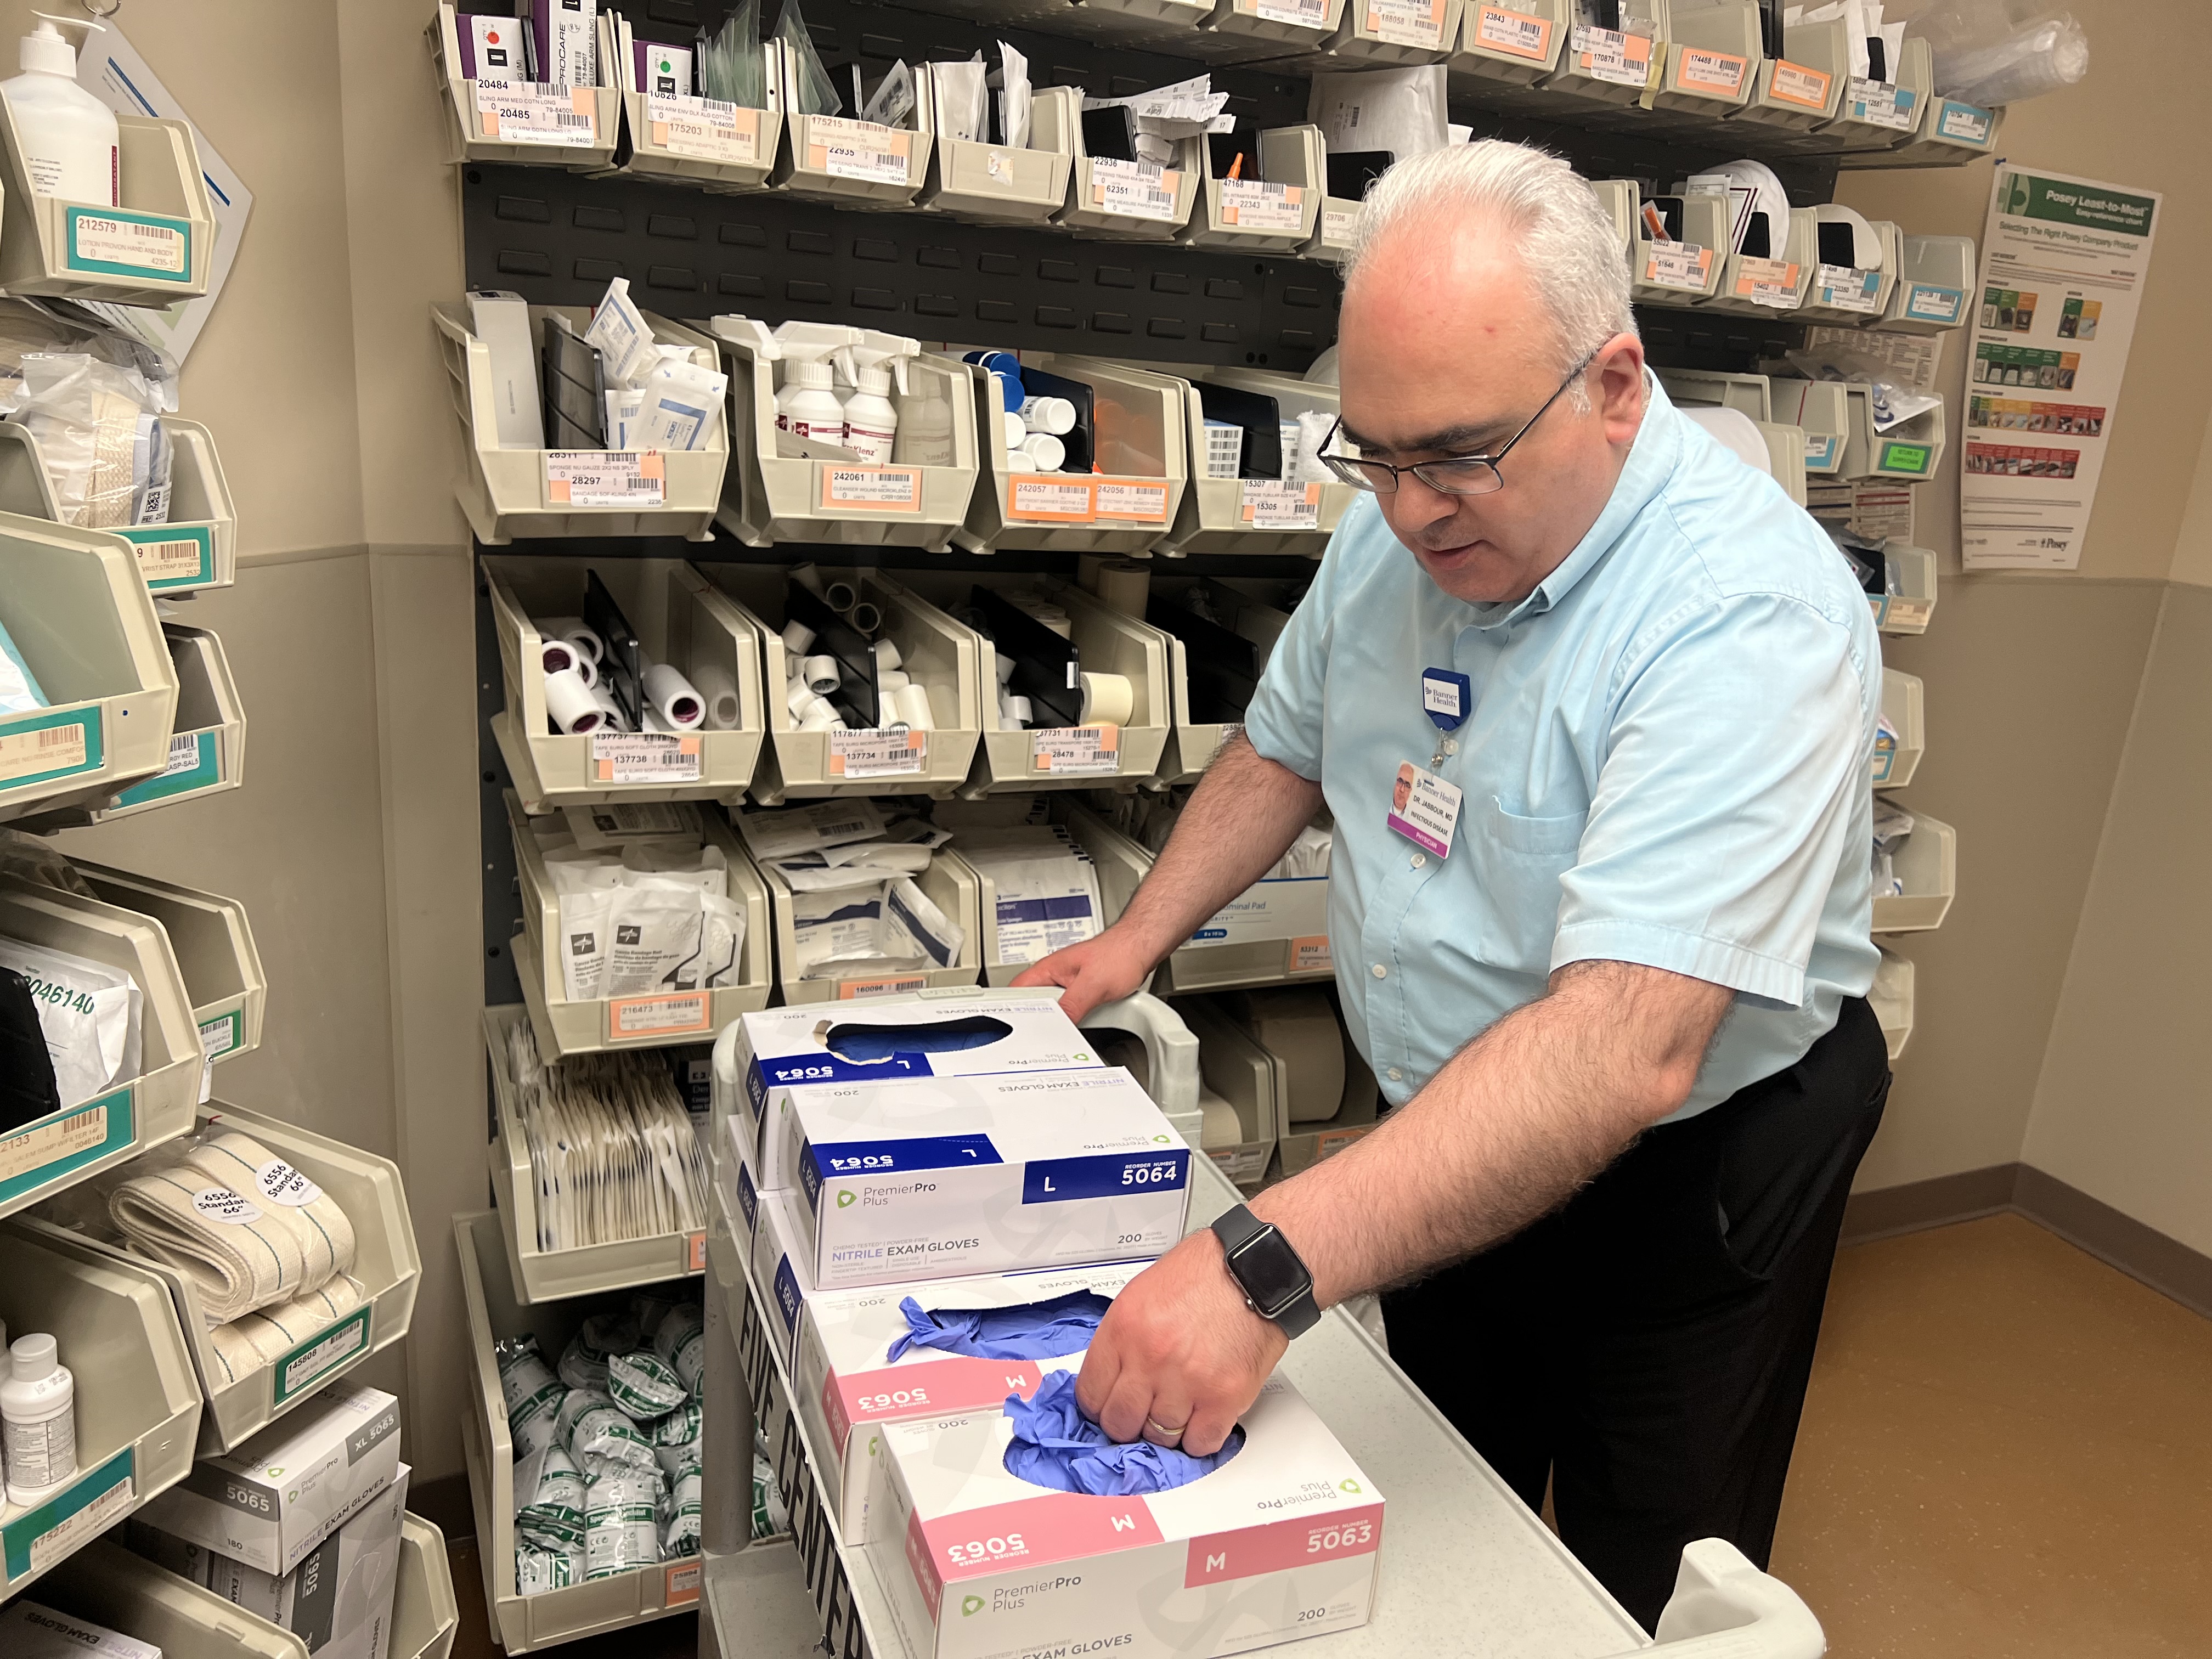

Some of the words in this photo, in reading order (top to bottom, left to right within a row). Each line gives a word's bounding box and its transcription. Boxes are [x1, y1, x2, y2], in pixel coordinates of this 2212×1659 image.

[1381, 14, 1404, 25] 188058
[1486, 12, 1505, 23] 23843
[1594, 53, 1615, 63] 170878
[1691, 55, 1712, 65] 174488
[478, 80, 508, 89] 20484
[500, 109, 529, 119] 20485
[811, 117, 843, 128] 175215
[669, 123, 702, 136] 175203
[830, 148, 854, 156] 22935
[1095, 156, 1118, 167] 22936
[1107, 185, 1128, 195] 62351
[1223, 180, 1244, 188] 47168
[2046, 190, 2078, 206] Posey
[1240, 200, 1260, 209] 22343
[1326, 213, 1345, 222] 29706
[78, 218, 116, 233] 212579
[1999, 221, 2029, 235] Selecting
[2031, 226, 2043, 235] The
[2044, 228, 2061, 239] Right
[2062, 232, 2080, 243] Posey
[2083, 235, 2112, 248] Company
[2113, 240, 2138, 250] Product
[78, 239, 100, 247] LOTION
[834, 473, 864, 481] 242061
[1018, 484, 1047, 493] 242057
[1097, 486, 1124, 494] 242056
[137, 548, 143, 557] 9
[1433, 689, 1457, 700] Banner
[1434, 697, 1456, 707] Health
[1, 758, 20, 767] CARE
[21, 752, 55, 763] NO-RINSE
[614, 755, 647, 764] 137738
[1422, 782, 1440, 798] Banner
[1440, 792, 1455, 807] Health
[1421, 800, 1444, 818] JABBOUR,
[1445, 812, 1453, 821] MD
[1410, 810, 1432, 827] INFECTIOUS
[1432, 823, 1448, 837] DISEASE
[1416, 832, 1437, 849] PHYSICIAN
[622, 1006, 653, 1014] 216473
[211, 1034, 231, 1046] BUCKLE
[896, 1060, 911, 1070] L
[1009, 1057, 1069, 1065] PremierPro
[775, 1065, 834, 1076] 5064
[1045, 1081, 1080, 1090] EXAM
[1082, 1078, 1126, 1086] NITRILE
[998, 1084, 1042, 1093] GLOVES
[13, 1147, 36, 1163] SALEM
[36, 1143, 57, 1155] SUMP
[57, 1131, 87, 1147] W/FILTER
[89, 1127, 99, 1135] 14F
[1084, 1139, 1149, 1150] PremierPro
[1121, 1135, 1146, 1143] Plus
[962, 1148, 978, 1158] L
[829, 1154, 894, 1167] 5064
[1153, 1160, 1177, 1169] NUMBER
[264, 1164, 286, 1185] 6556
[1043, 1176, 1057, 1193] L
[1121, 1166, 1178, 1185] 5064
[267, 1169, 299, 1198] Standar
[863, 1182, 937, 1197] PremierPro
[205, 1192, 236, 1201] 6556
[863, 1194, 889, 1207] Plus
[198, 1199, 250, 1210] Standar
[1118, 1233, 1142, 1244] 200
[832, 1248, 884, 1262] NITRILE
[887, 1243, 926, 1257] EXAM
[928, 1238, 980, 1253] GLOVES
[1038, 1279, 1088, 1290] GLOVES
[1090, 1279, 1126, 1289] EXAM
[859, 1298, 886, 1306] 200
[287, 1348, 317, 1372] 145808
[1005, 1374, 1027, 1389] M
[856, 1388, 928, 1409] 5063
[938, 1419, 969, 1430] 200
[355, 1438, 368, 1452] XL
[370, 1415, 394, 1440] 5065
[301, 1458, 338, 1487] PremierPro
[302, 1483, 316, 1495] Plus
[1300, 1480, 1331, 1495] Plus
[227, 1486, 269, 1513] 5065
[1256, 1488, 1338, 1511] PremierPro
[290, 1528, 323, 1561] NITRILE
[324, 1506, 349, 1530] EXAM
[351, 1476, 384, 1508] GLOVES
[1110, 1514, 1136, 1533] M
[1307, 1524, 1340, 1536] REORDER
[1341, 1519, 1369, 1531] NUMBER
[33, 1520, 73, 1549] 175222
[227, 1538, 243, 1550] 180
[947, 1533, 1026, 1563] 5063
[1205, 1551, 1226, 1573] M
[1306, 1525, 1372, 1554] 5063
[958, 1553, 992, 1567] NUMBER
[995, 1548, 1030, 1560] REORDER
[306, 1552, 320, 1596] 5065
[993, 1575, 1082, 1601] PremierPro
[992, 1595, 1025, 1613] Plus
[1297, 1606, 1327, 1623] 200
[27, 1613, 69, 1633] GLOVES
[67, 1623, 100, 1644] EXAM
[1071, 1633, 1133, 1655] GLOVES
